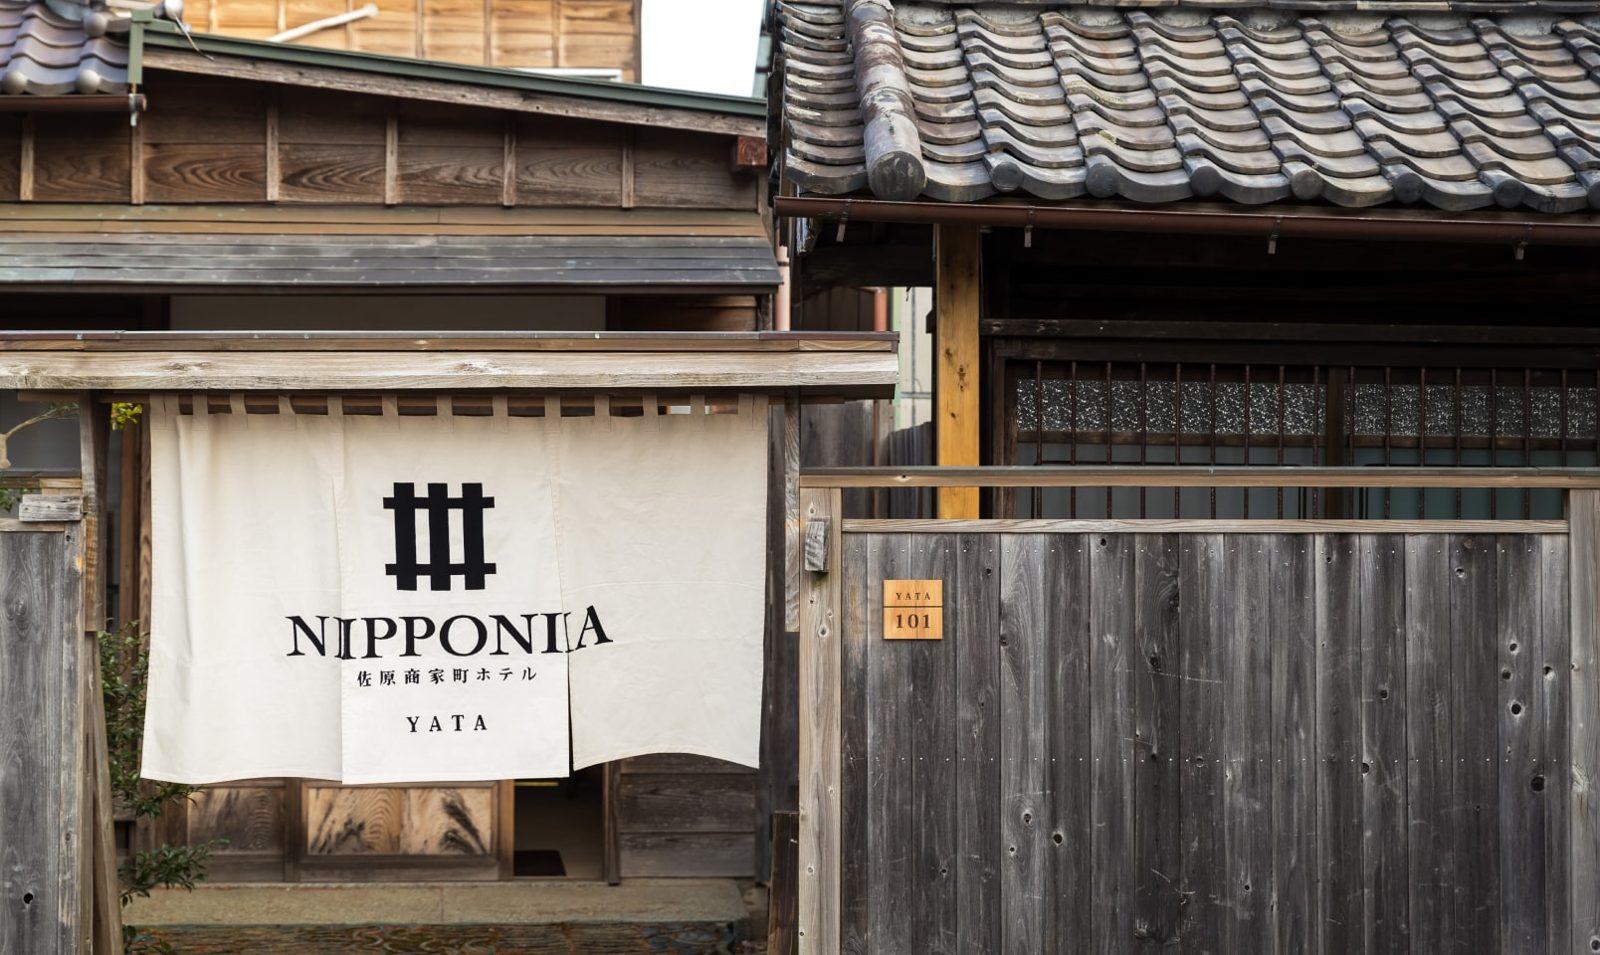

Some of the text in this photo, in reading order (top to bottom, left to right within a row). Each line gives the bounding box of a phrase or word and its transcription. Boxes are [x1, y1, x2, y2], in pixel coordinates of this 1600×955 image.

[895, 592, 931, 601] YATA
[896, 614, 931, 629] 101
[285, 605, 614, 660] NIPPONIA
[356, 667, 537, 687] 佐原商家町ホテル
[406, 714, 488, 733] YATA
